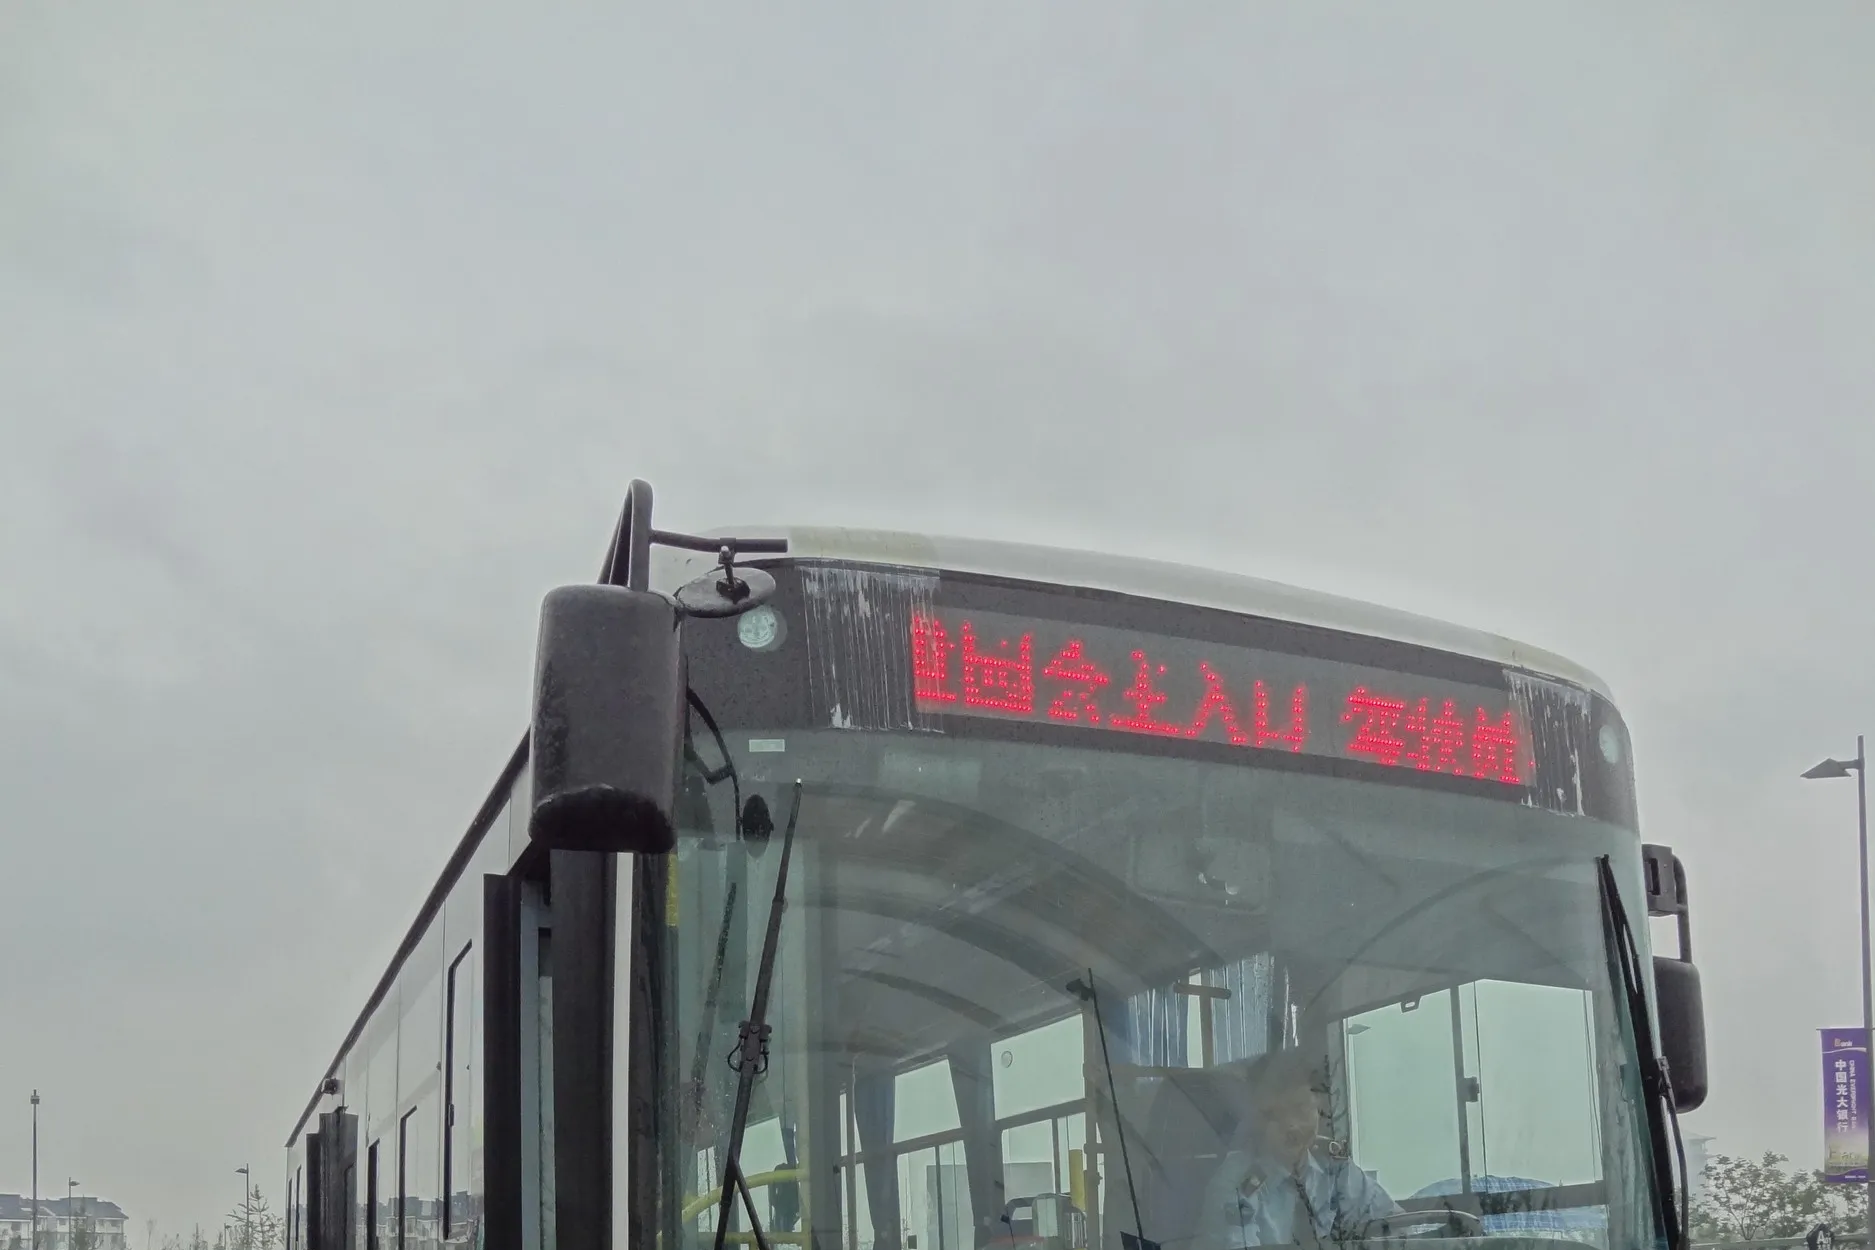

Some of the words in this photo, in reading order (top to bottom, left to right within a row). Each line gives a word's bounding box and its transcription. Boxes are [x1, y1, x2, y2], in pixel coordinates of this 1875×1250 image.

[1834, 1059, 1849, 1133] 中国光大银行
